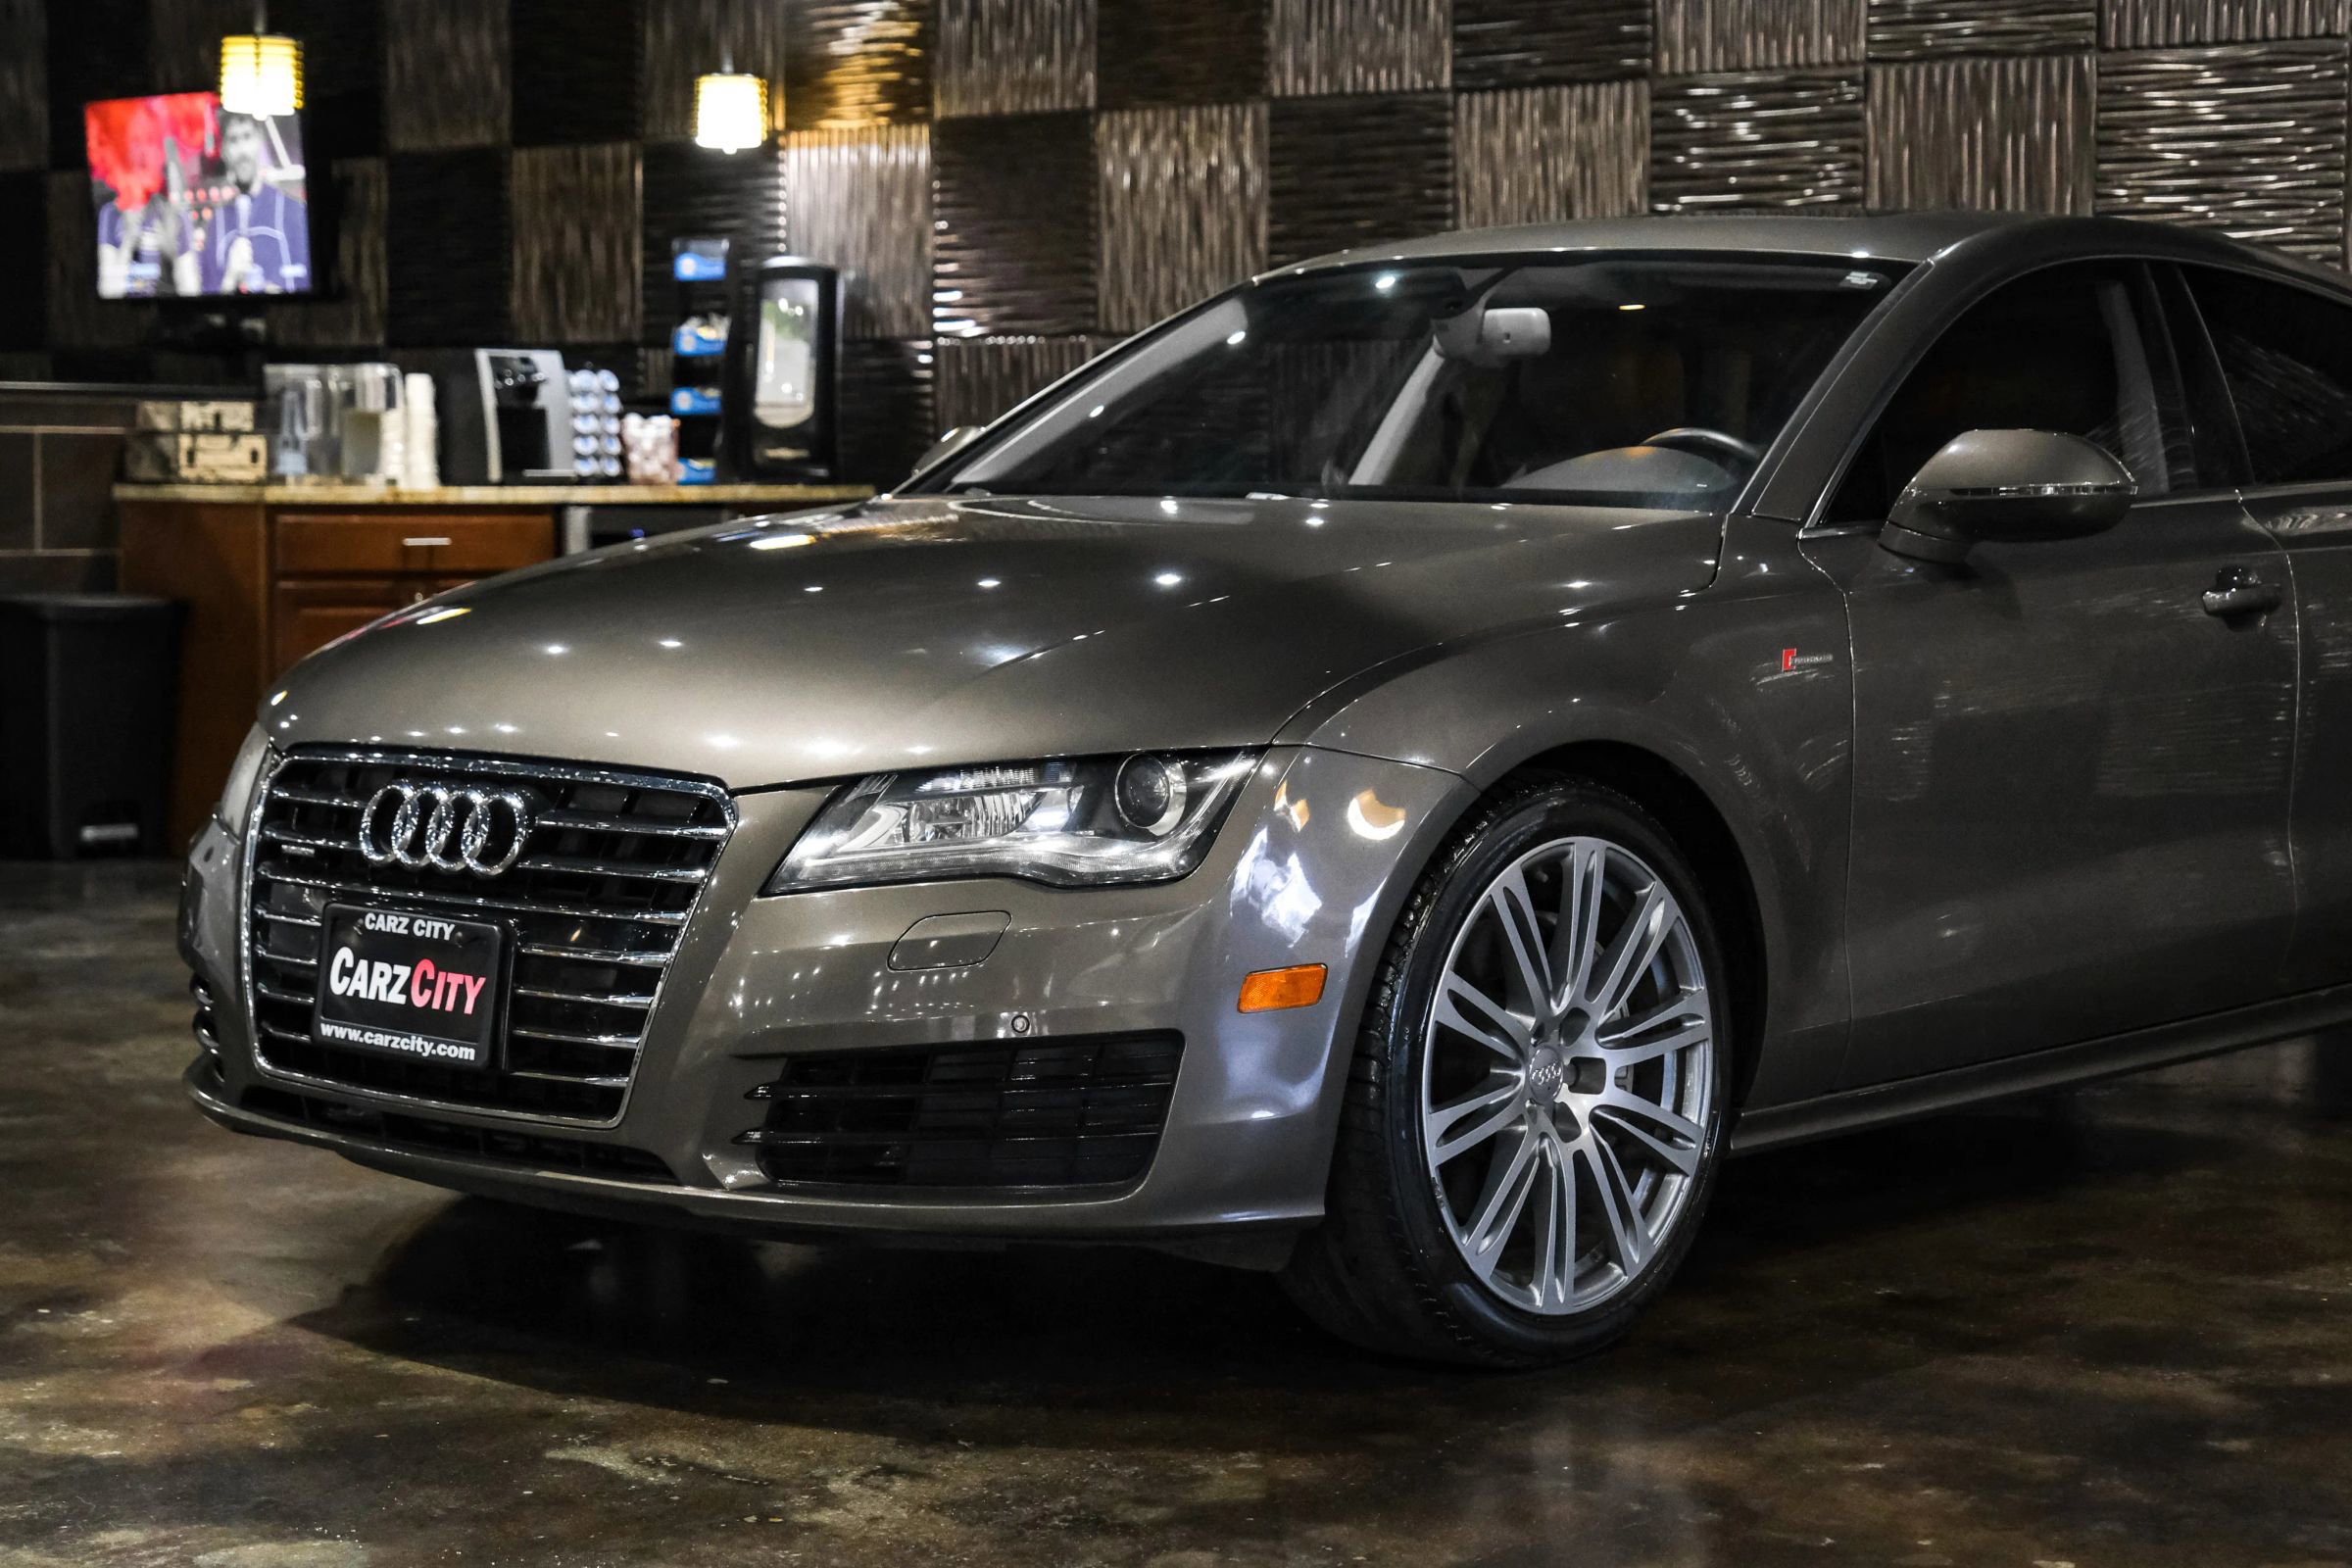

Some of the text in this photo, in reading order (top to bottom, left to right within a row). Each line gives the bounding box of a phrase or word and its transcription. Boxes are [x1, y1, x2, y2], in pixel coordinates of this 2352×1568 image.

[365, 912, 455, 941] CARZ CITY
[320, 1022, 475, 1060] www.carzcity.com
